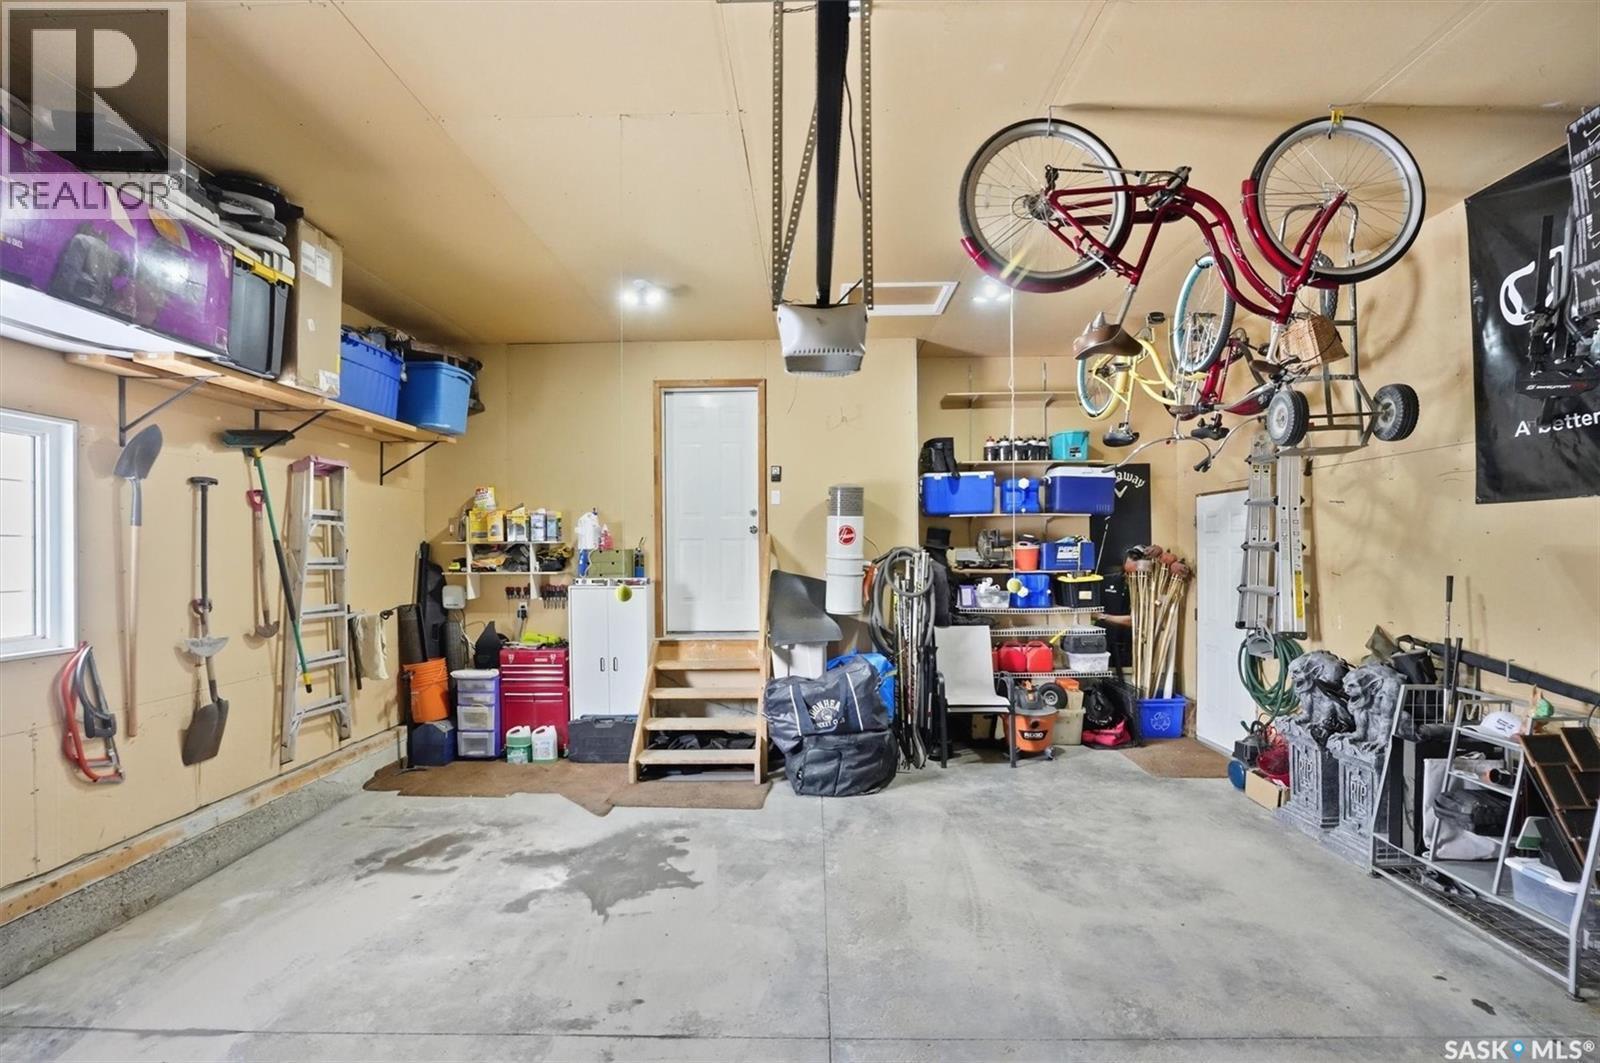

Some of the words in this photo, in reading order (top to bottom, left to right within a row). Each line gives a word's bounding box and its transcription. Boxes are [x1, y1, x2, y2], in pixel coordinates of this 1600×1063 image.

[1514, 420, 1531, 438] A
[1115, 472, 1146, 488] away
[1350, 780, 1367, 805] RIP
